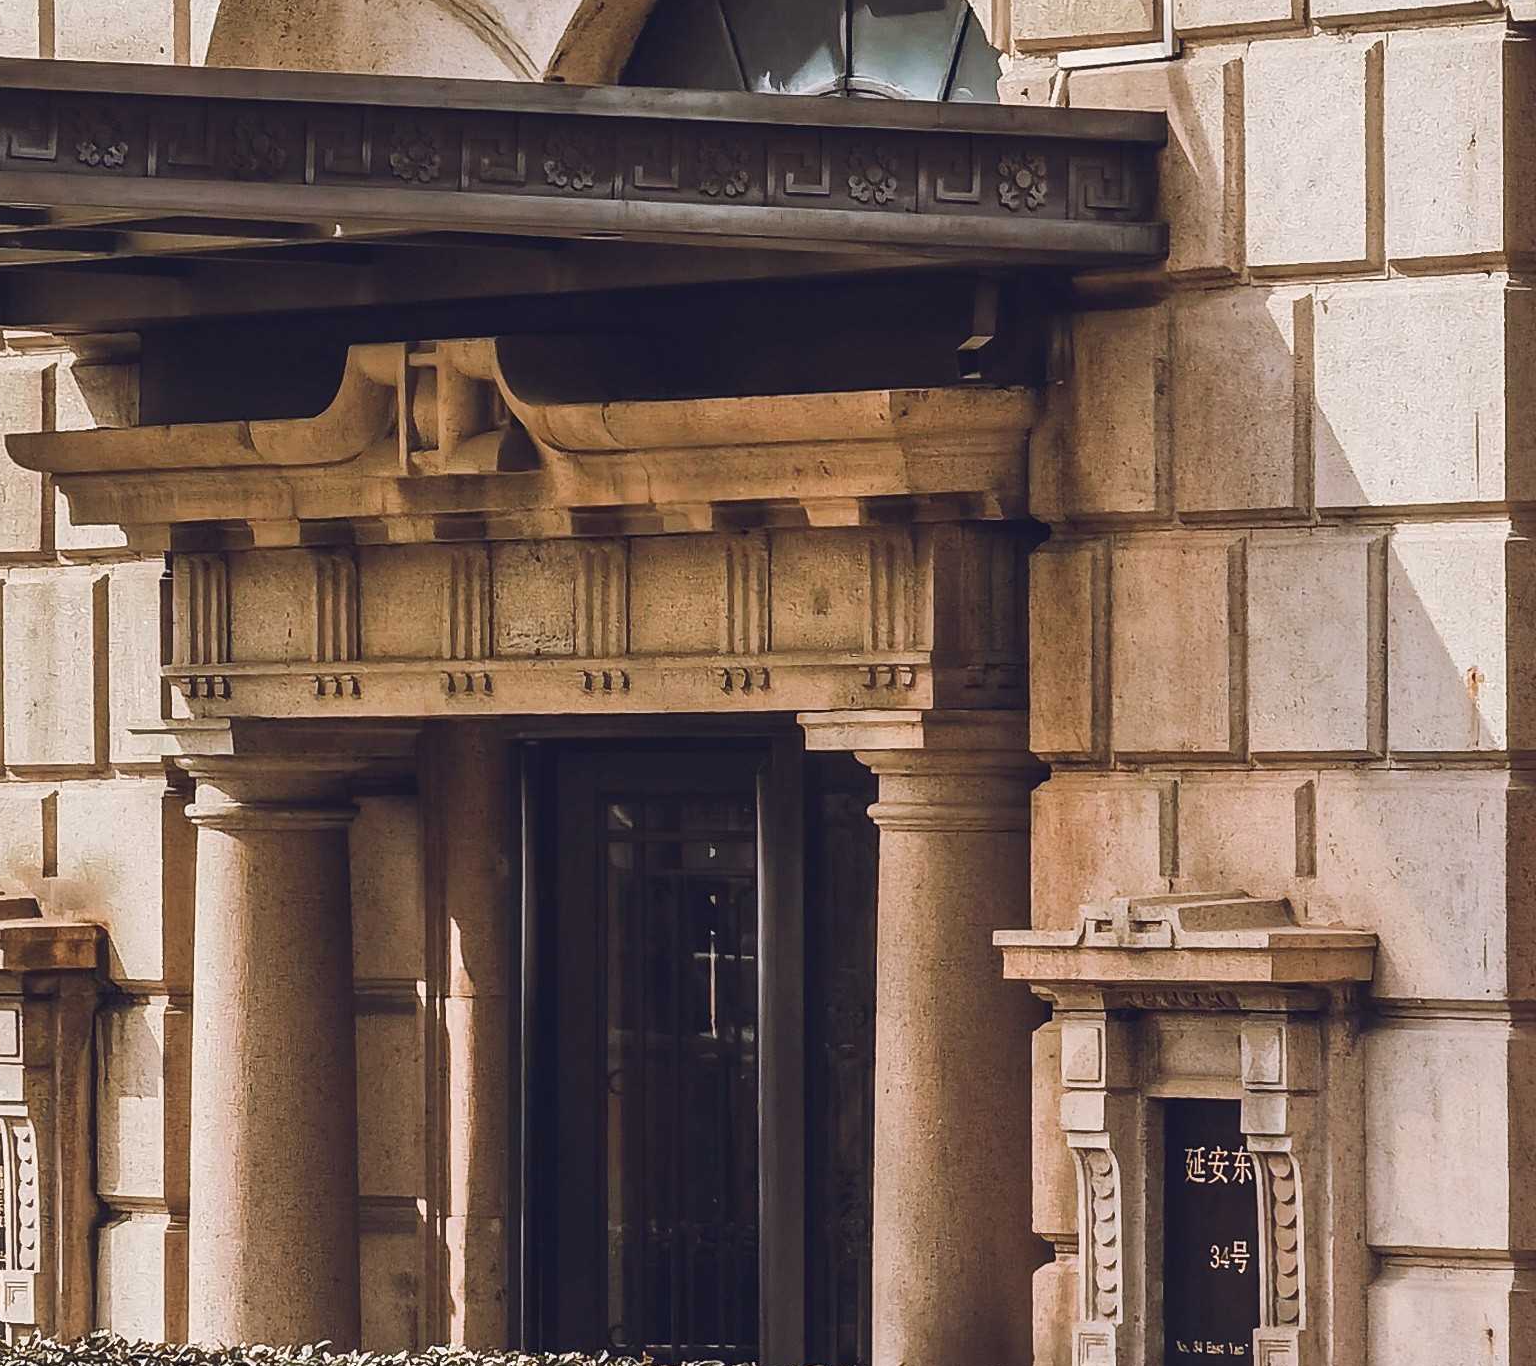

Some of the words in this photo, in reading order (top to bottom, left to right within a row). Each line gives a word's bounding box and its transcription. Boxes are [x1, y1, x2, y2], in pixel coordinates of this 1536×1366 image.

[1184, 1145, 1253, 1184] 延安东
[1209, 1241, 1250, 1274] 34号
